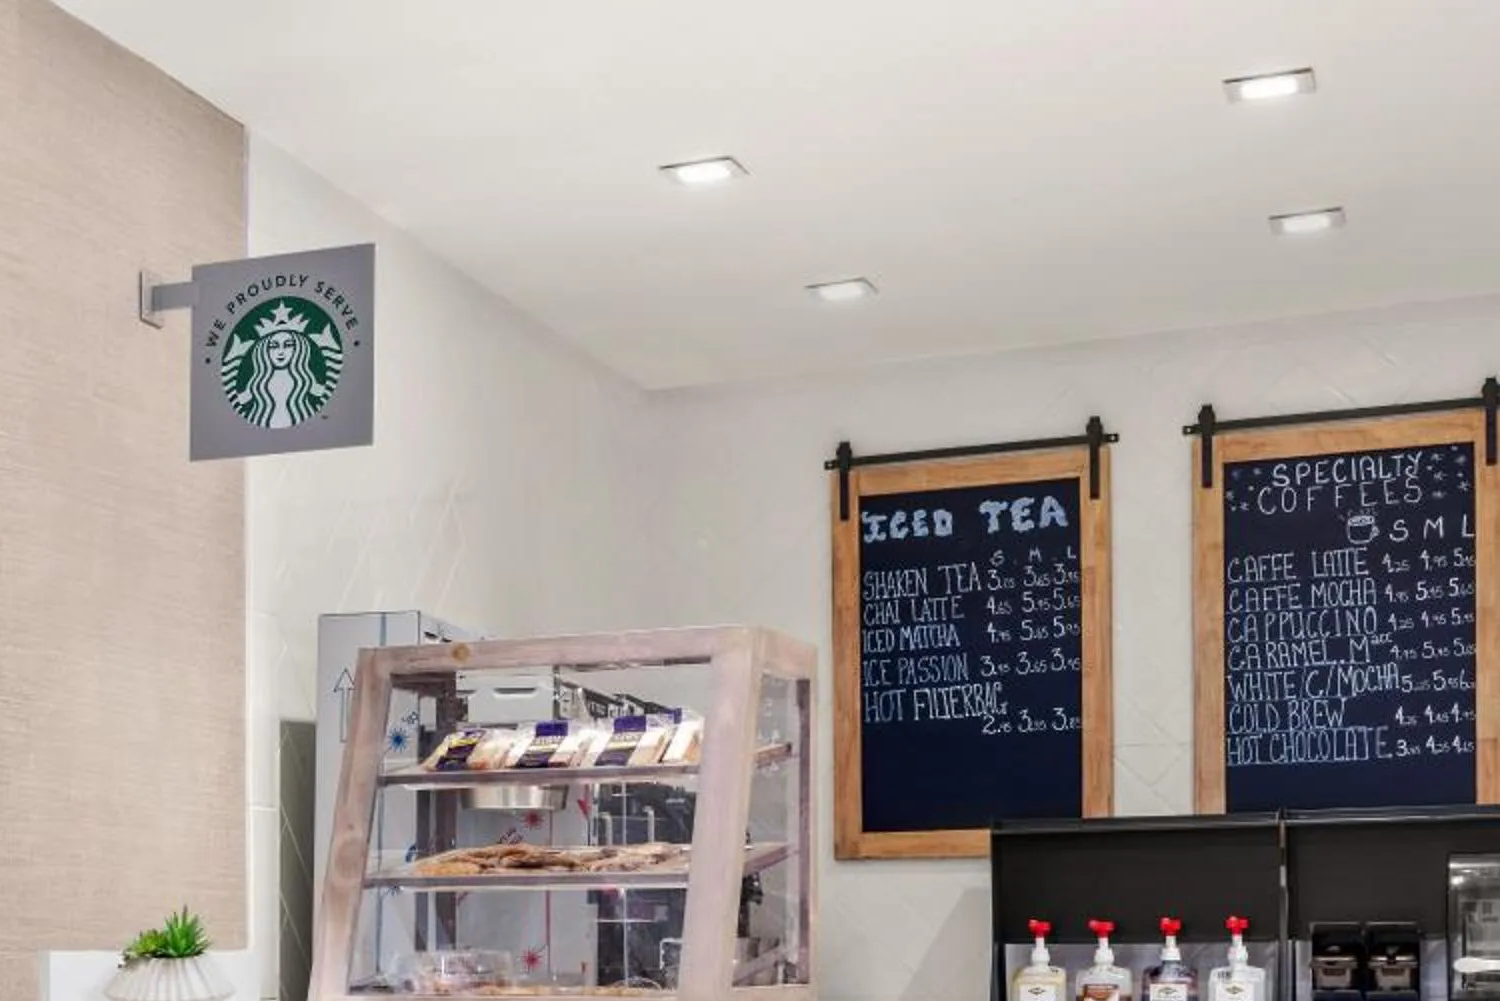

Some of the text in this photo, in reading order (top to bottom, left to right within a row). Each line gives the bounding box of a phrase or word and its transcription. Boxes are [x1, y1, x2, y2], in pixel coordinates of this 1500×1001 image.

[205, 273, 359, 347] WE PROUDLY SERVE
[1272, 452, 1422, 487] SPECIALTY
[1257, 478, 1423, 515] COFFEES
[861, 496, 1068, 543] ICED TEA
[1389, 515, 1476, 542] S M L
[1029, 546, 1042, 563] M
[1067, 546, 1077, 559] L
[1228, 553, 1298, 584] CAFFE
[1311, 548, 1369, 578] LATTE
[863, 568, 928, 600] SHAKEN
[938, 561, 982, 595] TEA
[1228, 583, 1302, 614] CAFFE
[1311, 577, 1377, 608] MOCHA
[864, 600, 900, 626] CHAI
[912, 596, 965, 623] LATTE
[1227, 606, 1378, 643] CAPPUCCINO
[862, 629, 895, 653] ICED
[900, 624, 960, 651] MATCHA
[1228, 639, 1331, 671] CARAMEL
[863, 659, 892, 687] ICE
[899, 652, 969, 685] PASSION
[1227, 670, 1298, 701] WHITE
[865, 688, 906, 722] HOT
[1229, 703, 1281, 735] COLD
[1287, 698, 1346, 732] BREW
[1227, 735, 1263, 766] HOT
[1268, 725, 1392, 765] CHOCOLATE
